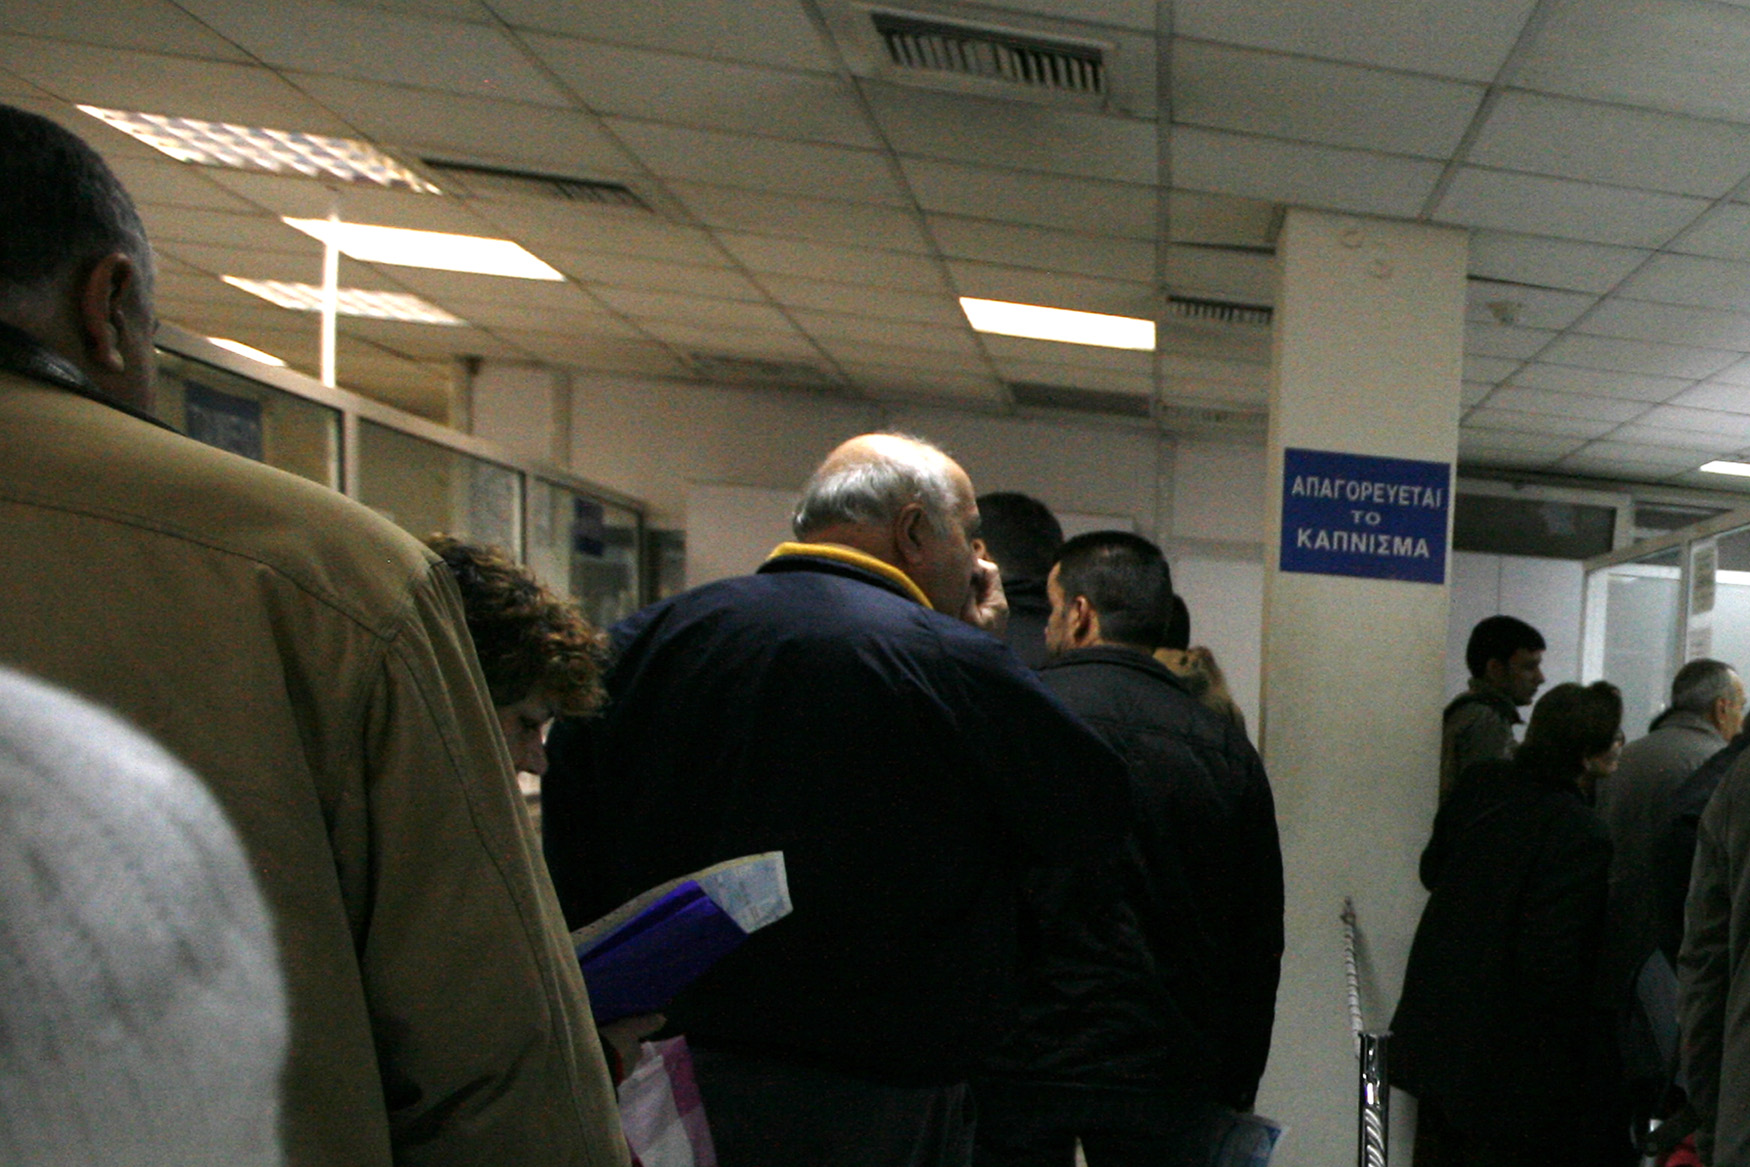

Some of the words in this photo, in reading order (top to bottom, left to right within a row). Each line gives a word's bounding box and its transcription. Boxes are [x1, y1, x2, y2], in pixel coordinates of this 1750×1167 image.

[1291, 475, 1443, 508] ΑΠΑΓΟΡΕΥΕΤΑΙ
[1351, 510, 1382, 526] ΤΟ
[1297, 527, 1430, 559] ΚΑΠΝΙΣΜΑ
